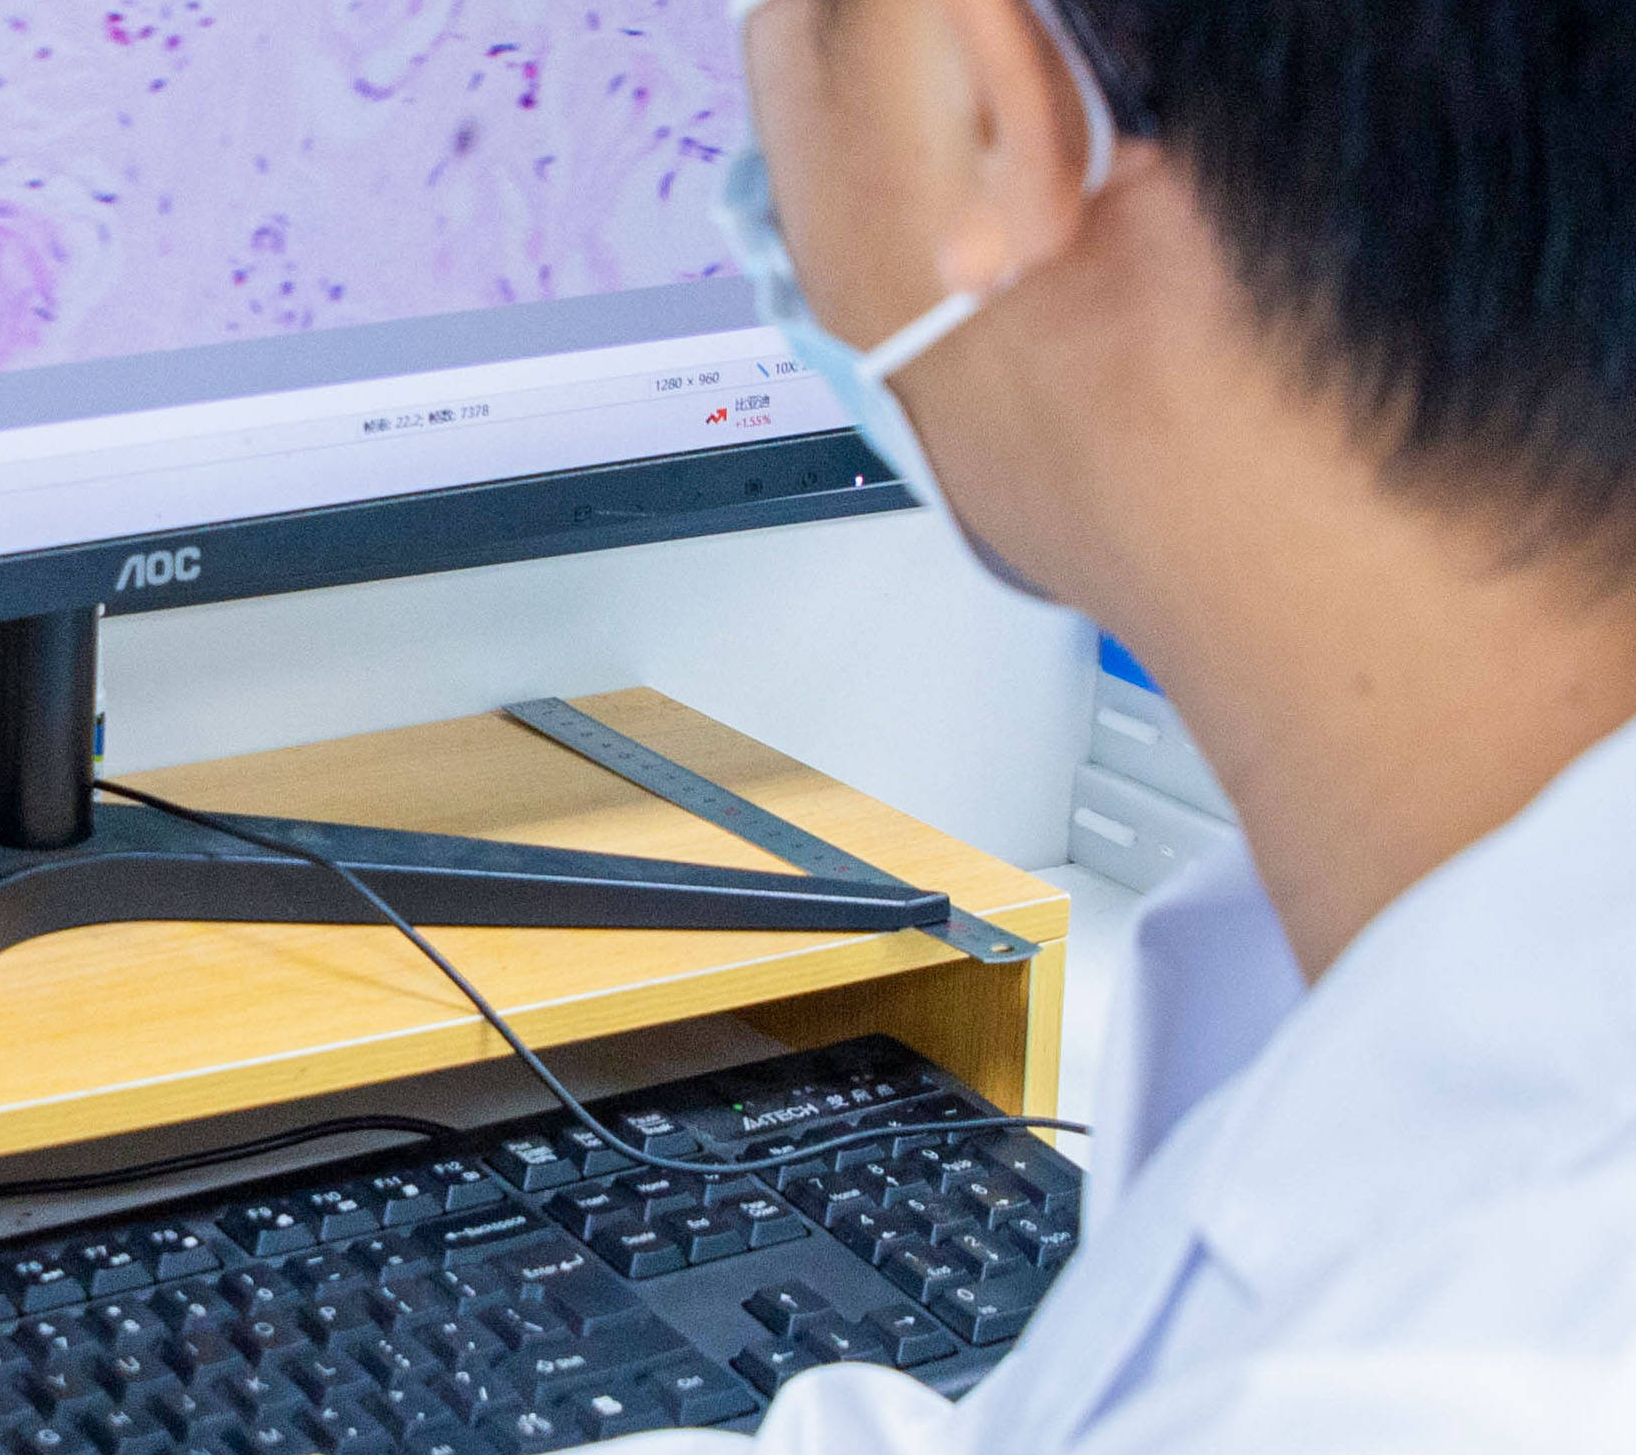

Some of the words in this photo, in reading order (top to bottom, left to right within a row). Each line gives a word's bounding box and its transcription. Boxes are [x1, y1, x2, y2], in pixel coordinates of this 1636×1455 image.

[655, 378, 682, 392] 1280
[699, 372, 720, 385] 960
[735, 396, 770, 411] 比亚迪
[115, 546, 201, 591] AOC
